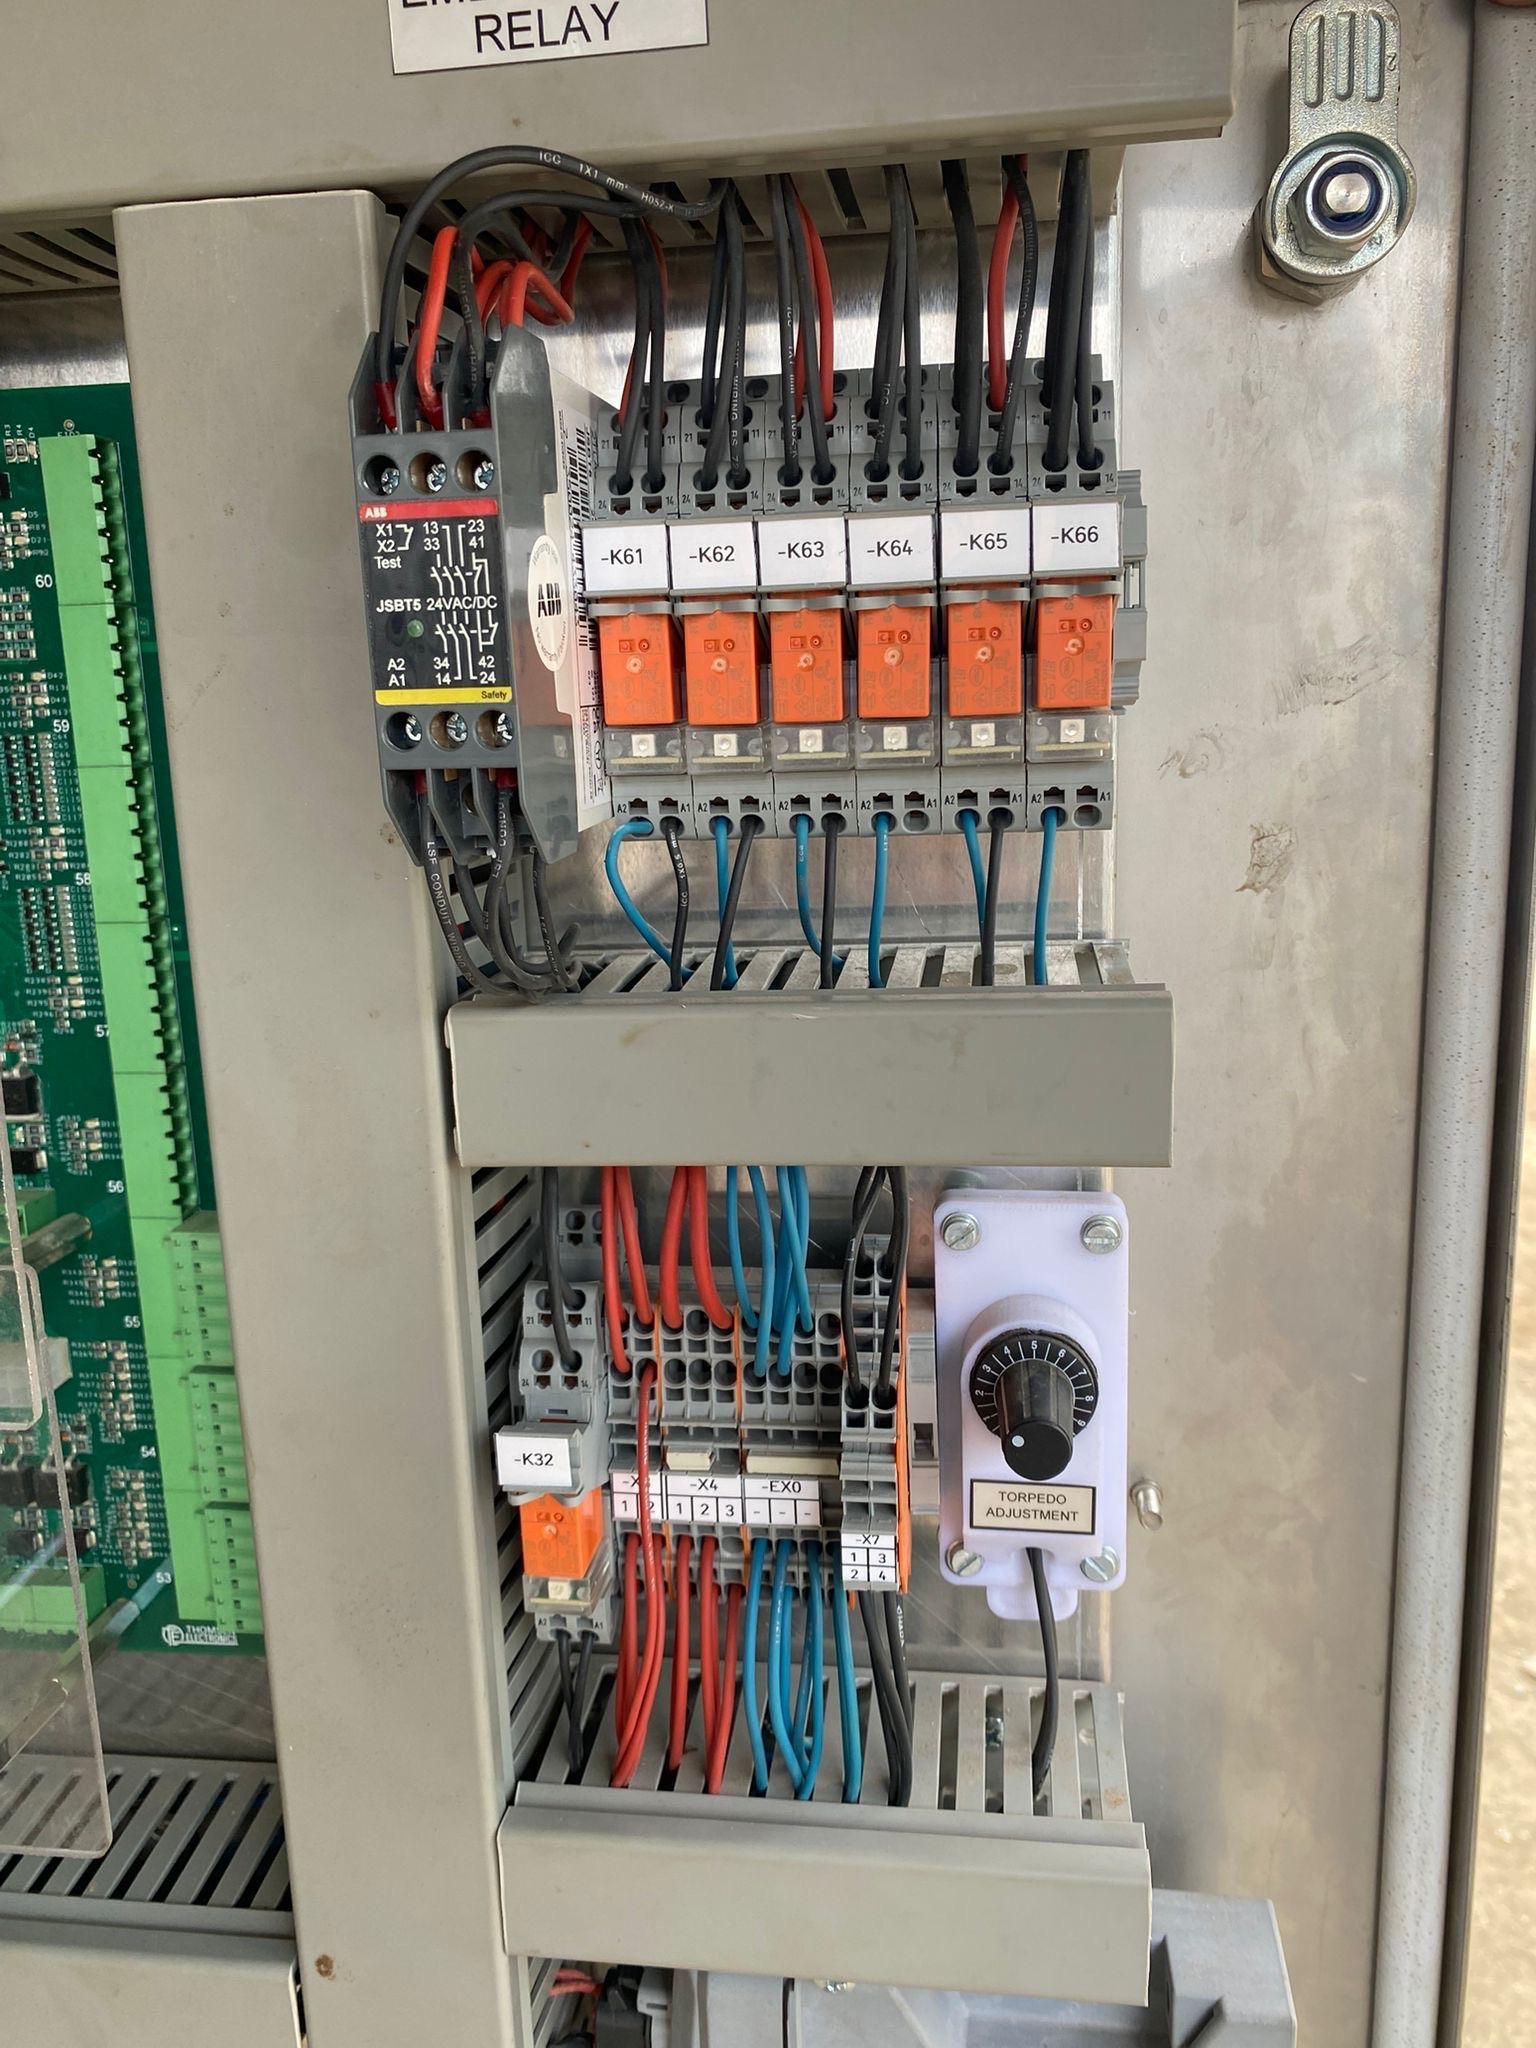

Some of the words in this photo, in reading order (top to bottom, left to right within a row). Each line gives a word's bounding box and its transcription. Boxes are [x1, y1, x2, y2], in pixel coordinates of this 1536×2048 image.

[474, 1, 620, 53] RELAY
[364, 507, 387, 518] ABB
[376, 524, 393, 536] X1
[423, 521, 439, 534] 13
[467, 519, 485, 532] 23
[959, 532, 1008, 550] -K65
[1051, 526, 1099, 544] -K66
[377, 540, 395, 552] X2
[423, 538, 440, 550] 33
[469, 536, 485, 548] 41
[689, 545, 735, 563] -K62
[778, 541, 824, 559] -K63
[867, 540, 913, 557] -K64
[374, 556, 402, 569] Test
[601, 548, 643, 565] -K61
[35, 574, 53, 588] 60
[376, 598, 422, 612] JSBT5
[427, 596, 498, 611] 24VAC/DC
[387, 658, 406, 670] A2
[433, 657, 450, 669] 34
[478, 655, 495, 668] 42
[388, 674, 406, 686] A1
[435, 673, 451, 685] 14
[479, 671, 496, 684] 24
[481, 690, 507, 700] Safety
[53, 719, 70, 733] 59
[944, 795, 955, 805] A2
[1012, 793, 1023, 803] A1
[1031, 793, 1042, 803] A2
[1100, 791, 1111, 801] A1
[617, 803, 628, 813] A2
[680, 802, 690, 812] A1
[697, 802, 708, 812] A2
[762, 800, 772, 810] A1
[778, 801, 789, 811] A2
[843, 799, 854, 809] A1
[860, 800, 871, 810] A2
[927, 798, 937, 808] A1
[426, 841, 438, 865] LSF
[75, 872, 91, 885] 58
[430, 872, 452, 926] CONDUIT
[447, 931, 466, 969] WIRING
[107, 1180, 124, 1193] 56
[124, 1315, 141, 1328] 55
[526, 1316, 534, 1324] 21
[585, 1317, 592, 1325] 11
[141, 1445, 156, 1458] 54
[514, 1453, 554, 1467] -K32
[690, 1478, 718, 1491] -X4
[998, 1490, 1067, 1505] TORPEDO
[622, 1500, 628, 1512] 1
[676, 1503, 682, 1514] 1
[700, 1504, 709, 1515] 2
[725, 1505, 735, 1517] 3
[985, 1507, 1079, 1522] ADJUSTMENT
[856, 1534, 880, 1545] -X7
[850, 1552, 856, 1562] 1
[878, 1553, 886, 1563] 3
[156, 1572, 172, 1583] 53
[850, 1569, 859, 1579] 2
[878, 1570, 886, 1580] 4
